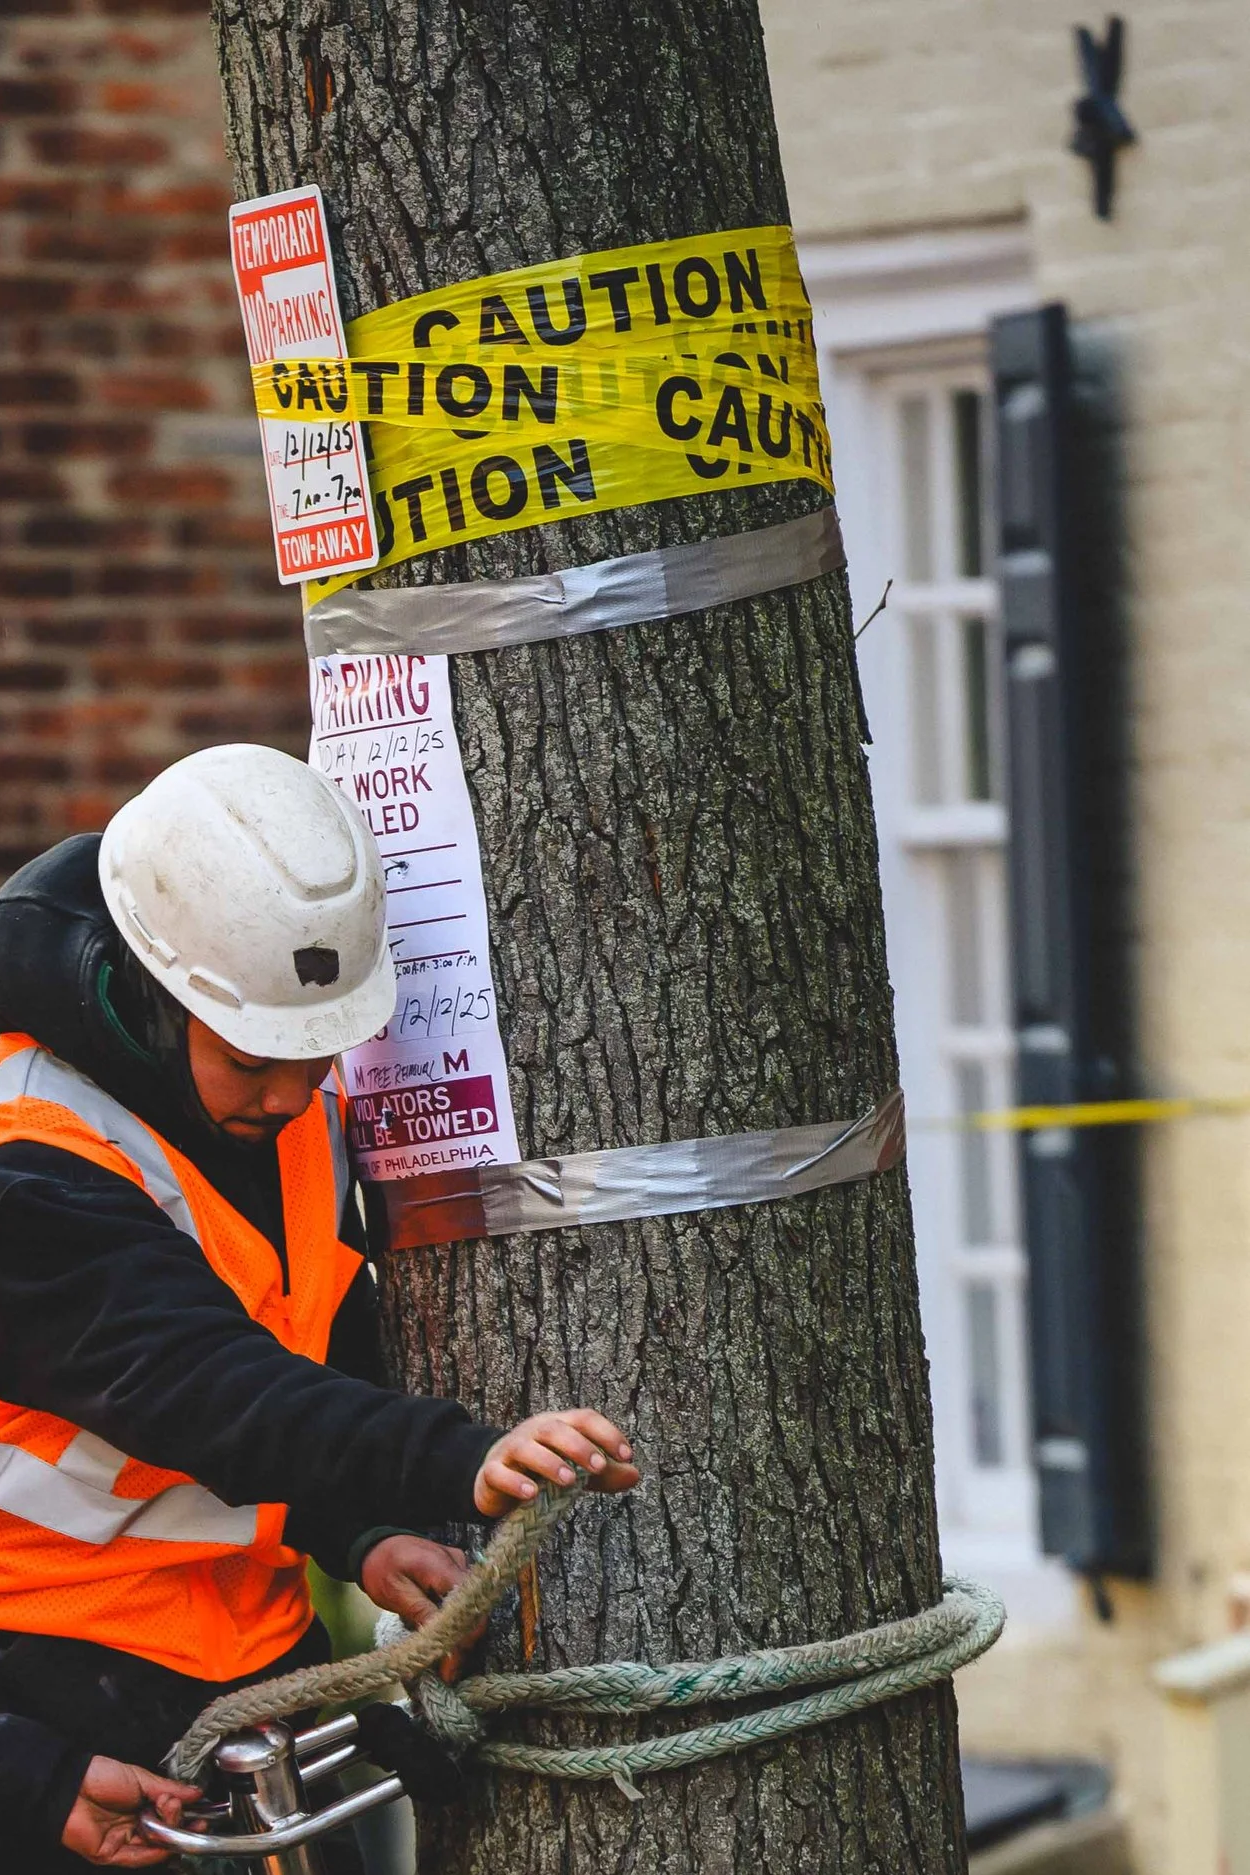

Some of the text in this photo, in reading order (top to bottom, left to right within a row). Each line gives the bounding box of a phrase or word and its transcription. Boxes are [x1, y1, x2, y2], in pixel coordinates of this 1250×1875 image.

[236, 207, 319, 271] TEMPORARY
[244, 289, 332, 367] NO PARKING
[271, 361, 558, 424] CAUTION
[281, 521, 365, 569] TOW-AWAY
[367, 727, 445, 767] 12/12/25
[353, 763, 433, 802] WORK
[400, 984, 491, 1037] 12/12/25
[443, 1049, 470, 1075] M
[354, 1086, 451, 1122] VIOLATORS
[374, 1124, 396, 1146] BE
[403, 1107, 494, 1142] TOWED
[385, 1144, 495, 1173] PHILADELPHIA
